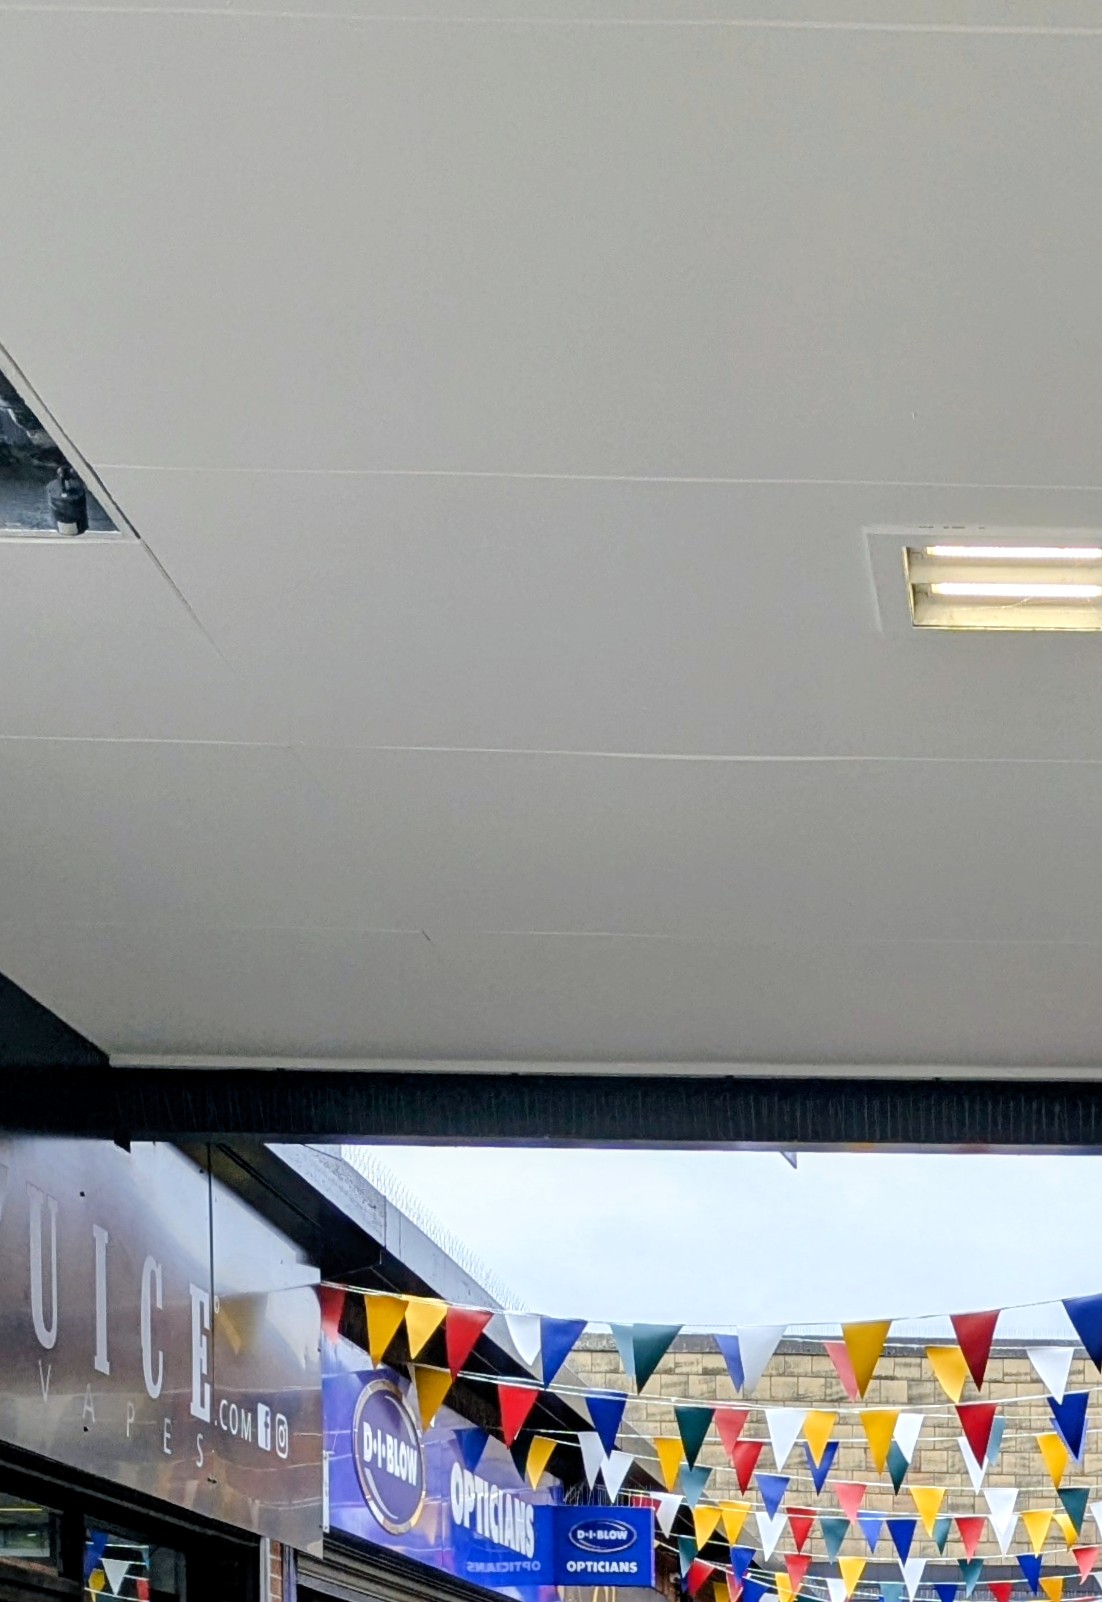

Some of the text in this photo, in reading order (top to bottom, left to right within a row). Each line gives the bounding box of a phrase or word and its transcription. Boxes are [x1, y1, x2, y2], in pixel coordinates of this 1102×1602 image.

[0, 1162, 211, 1423] UICE
[37, 1359, 205, 1468] VAPES
[450, 1461, 536, 1560] OPTICIANS
[566, 1561, 639, 1574] OPTICIANS
